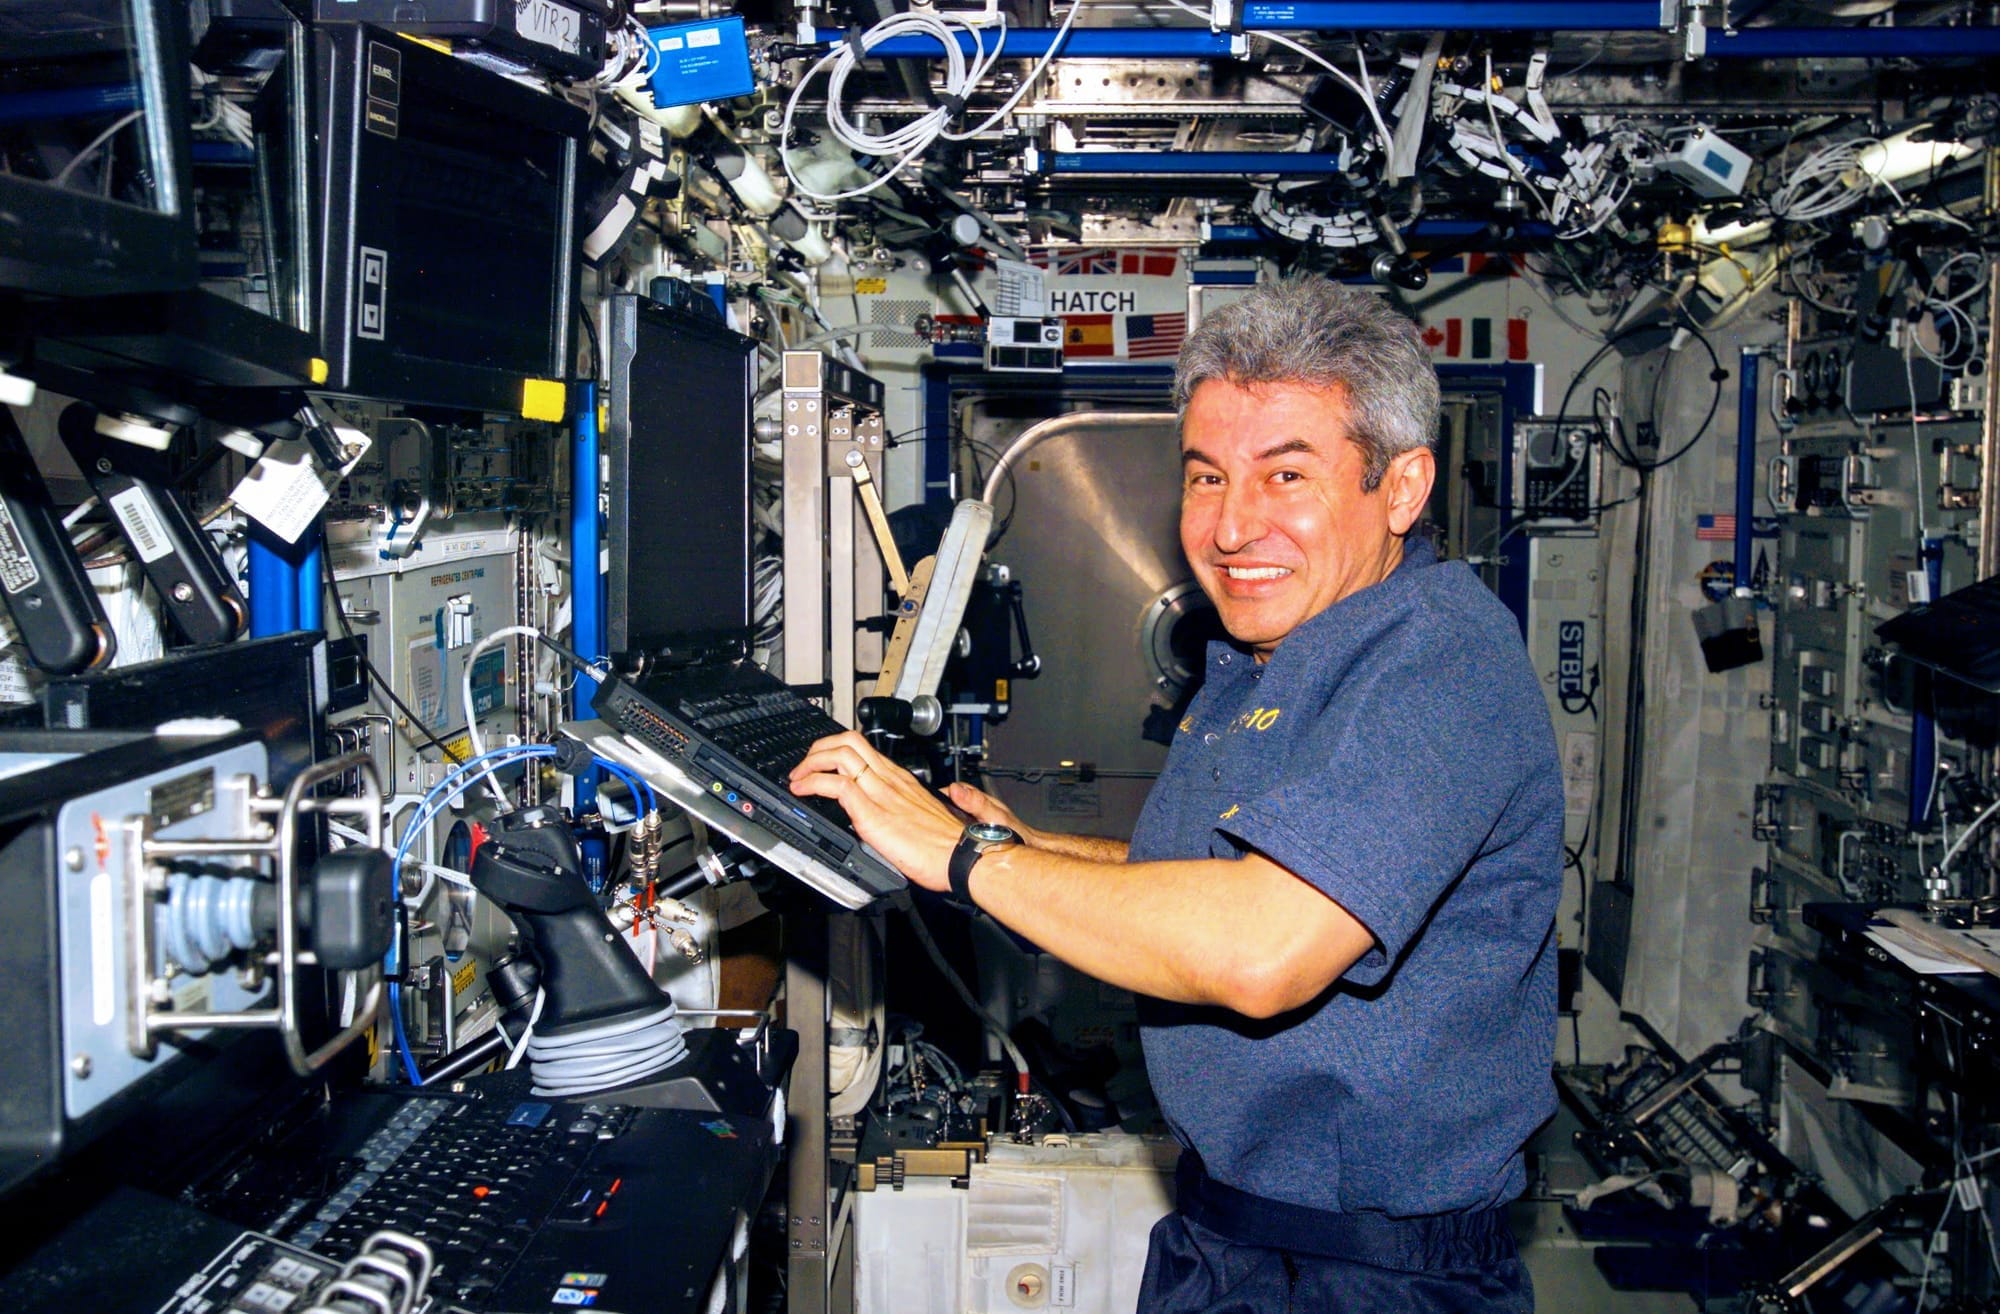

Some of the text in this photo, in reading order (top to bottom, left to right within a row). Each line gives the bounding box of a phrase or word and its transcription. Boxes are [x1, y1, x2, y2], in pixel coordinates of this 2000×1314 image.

[534, 2, 572, 44] VTR 2
[1051, 291, 1135, 312] HATCH
